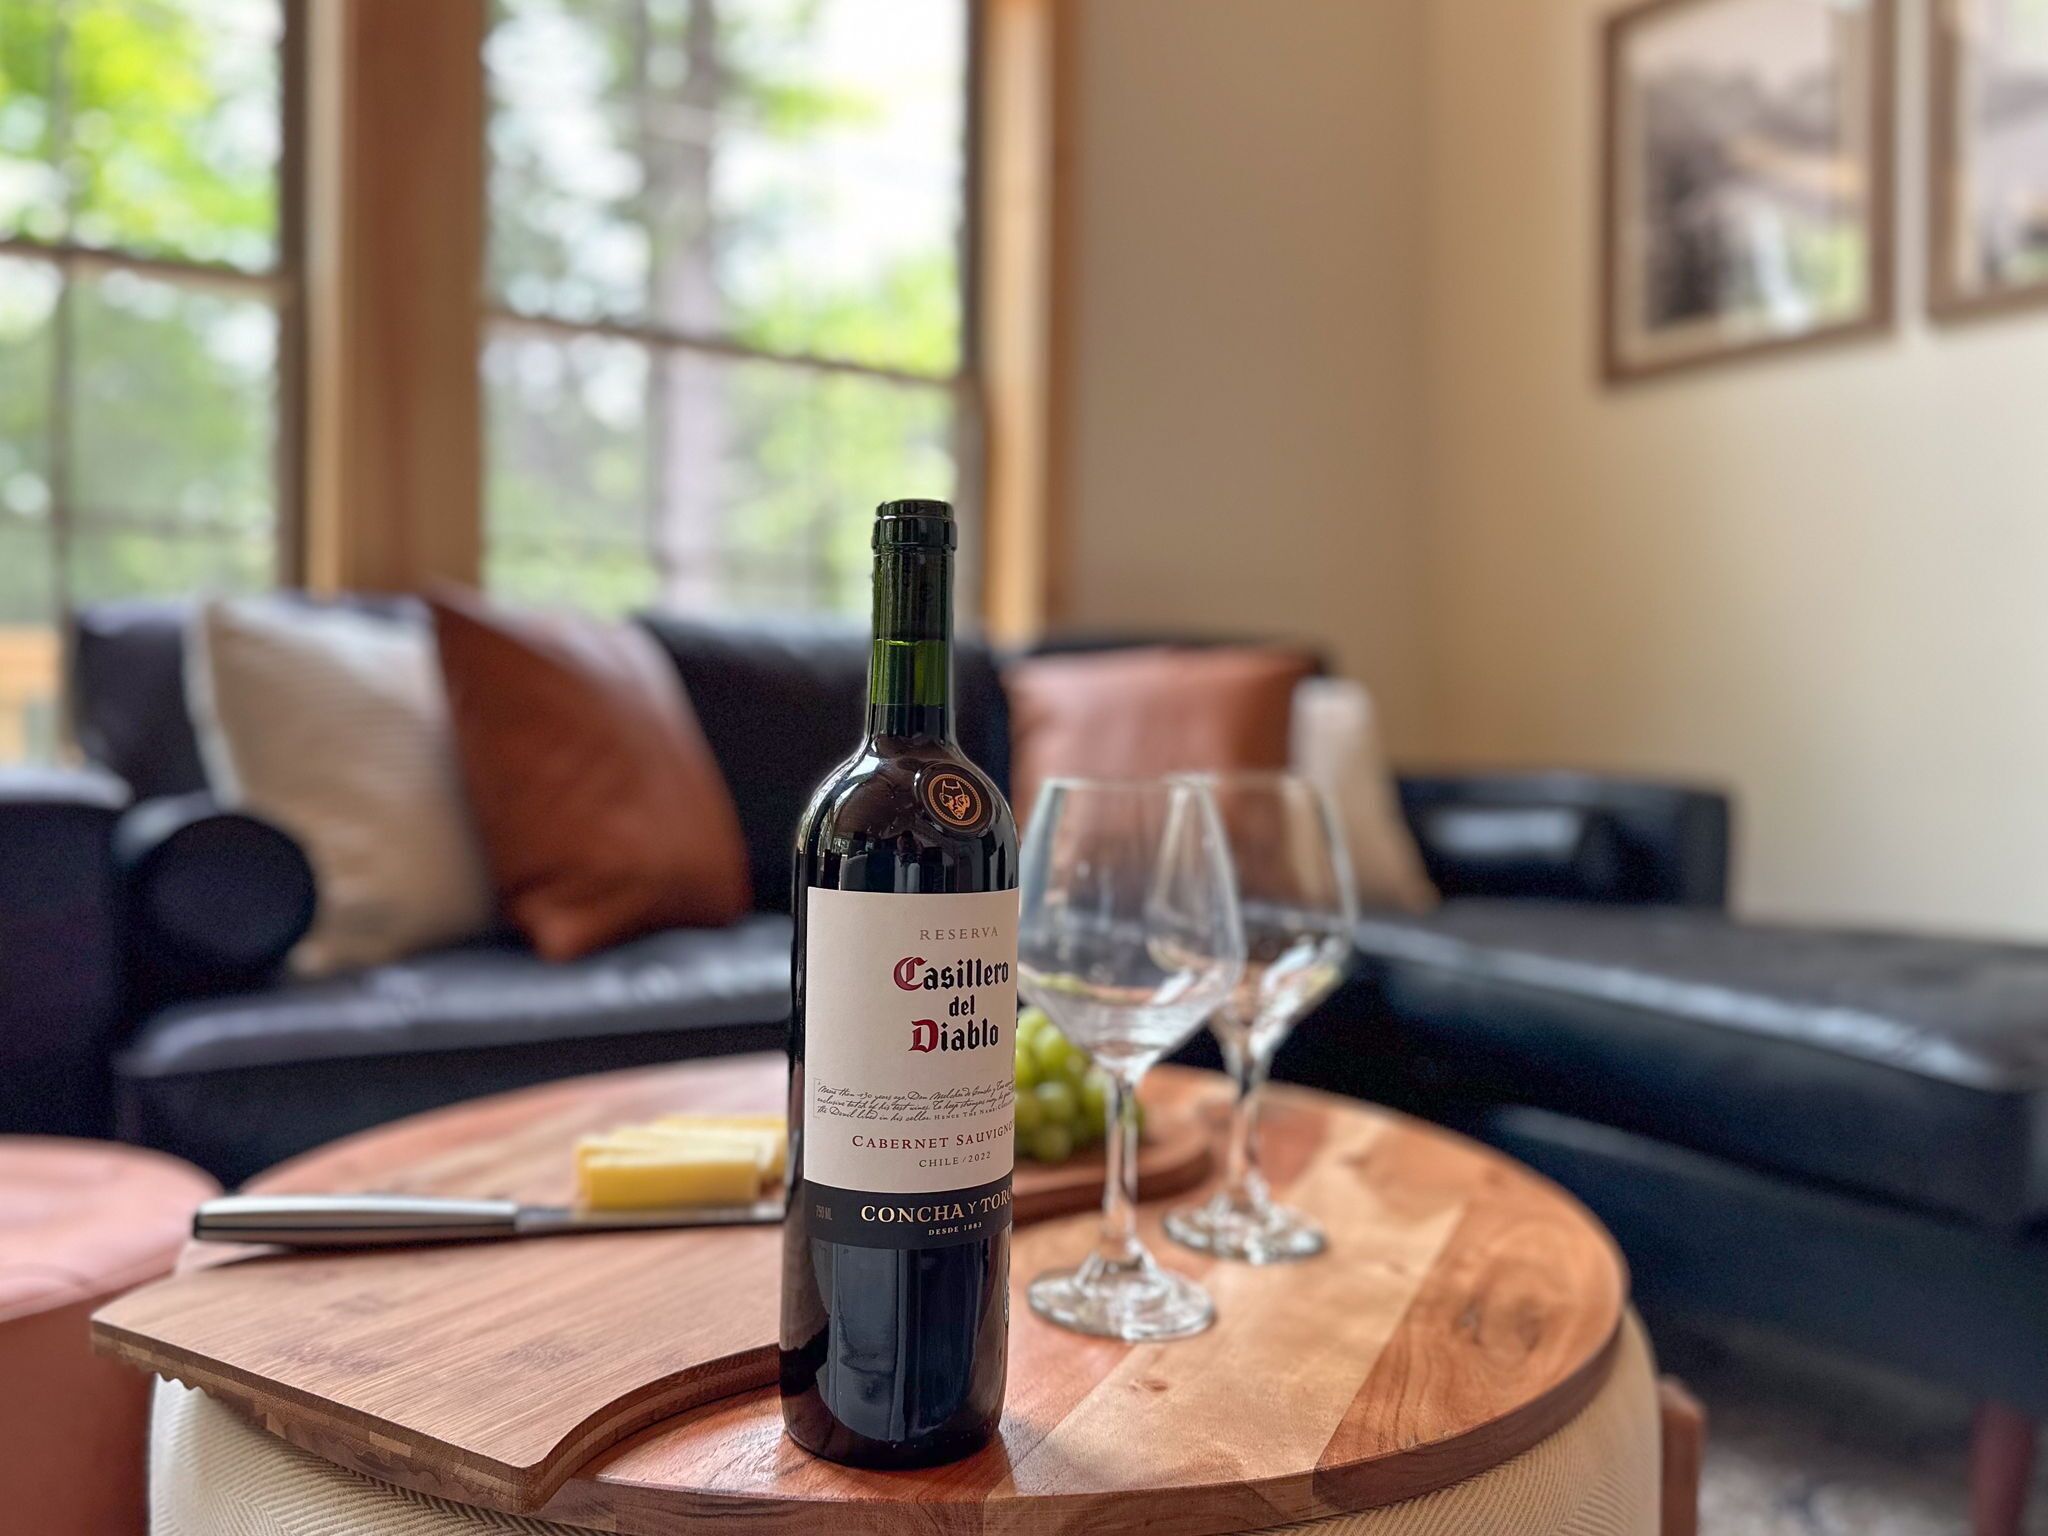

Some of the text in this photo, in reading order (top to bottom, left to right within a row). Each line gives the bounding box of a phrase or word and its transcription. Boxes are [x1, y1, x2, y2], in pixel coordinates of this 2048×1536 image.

[920, 926, 998, 940] RESERVA
[893, 956, 1009, 991] Casillero
[948, 994, 975, 1017] del
[908, 1018, 999, 1053] Diablo
[852, 1121, 1013, 1150] CABERNET SAUVIGNO
[861, 1202, 965, 1223] CONCHA
[967, 1200, 978, 1214] Y
[928, 1221, 982, 1236] DESDE 1883
